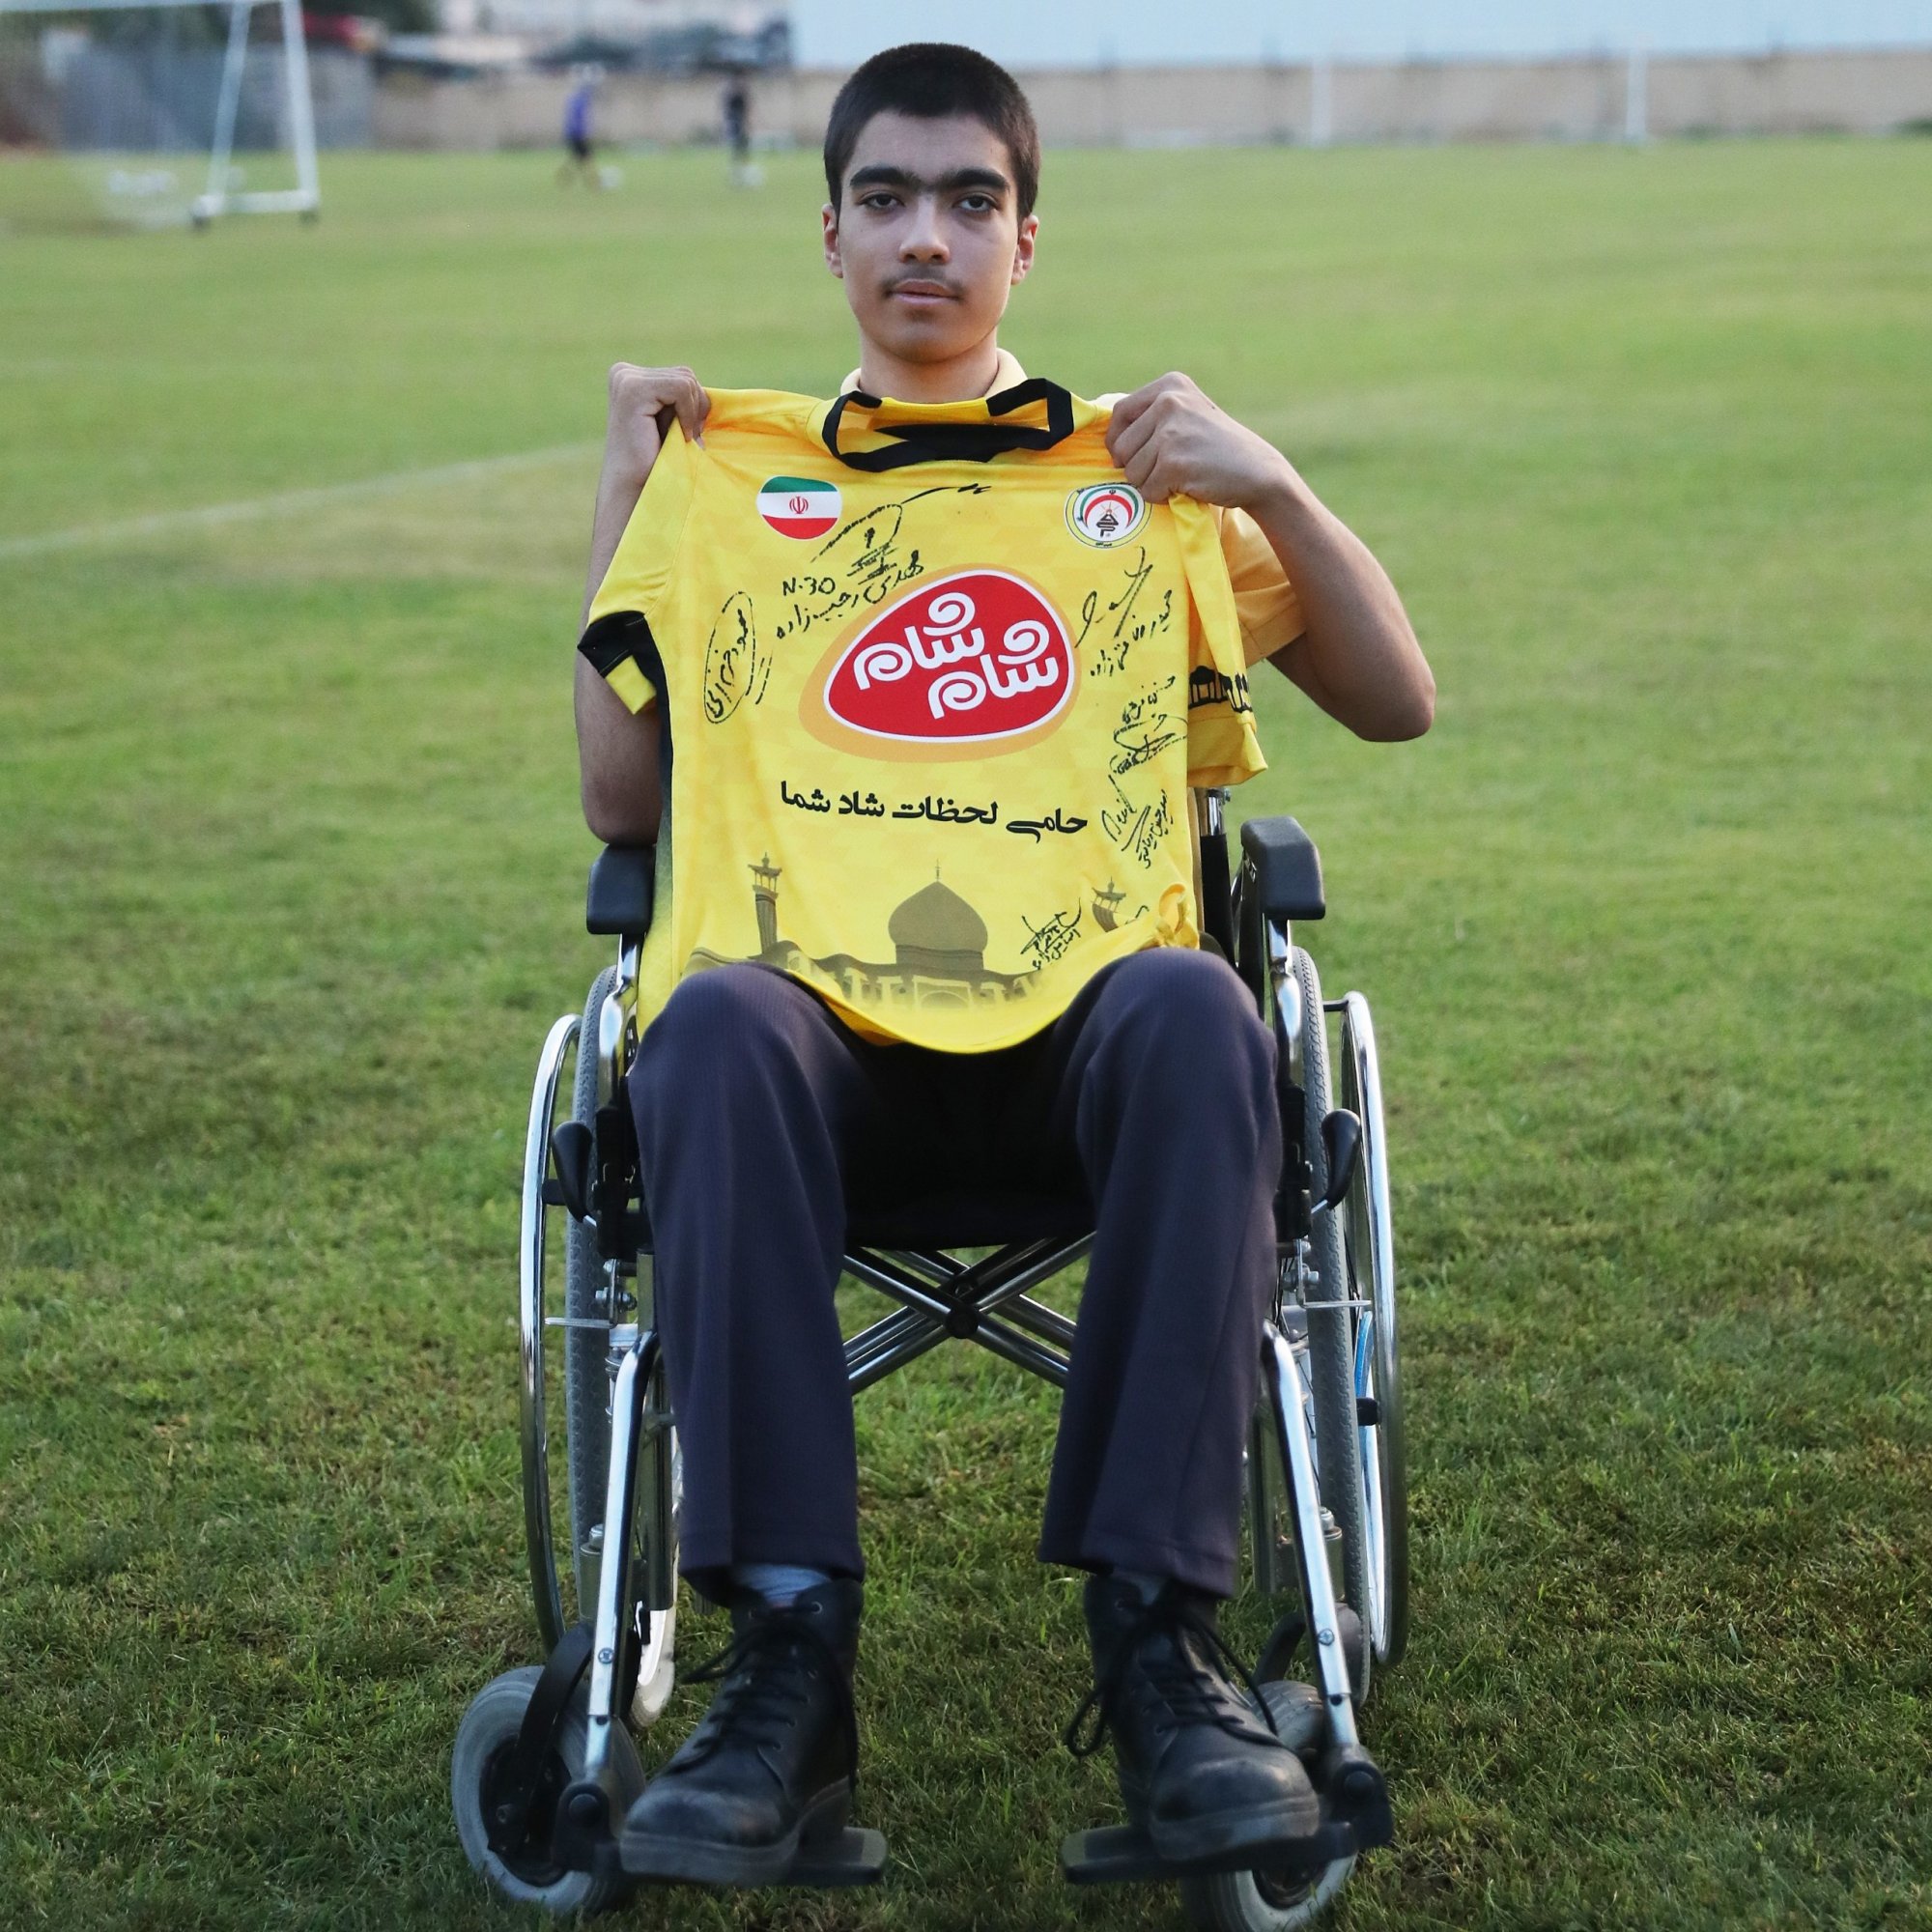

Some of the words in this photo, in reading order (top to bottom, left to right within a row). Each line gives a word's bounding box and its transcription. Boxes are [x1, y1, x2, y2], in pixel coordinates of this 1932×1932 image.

[781, 781, 831, 813] شما
[838, 791, 885, 817] شاد
[893, 796, 998, 824] لحظات
[1006, 809, 1088, 843] حامی
